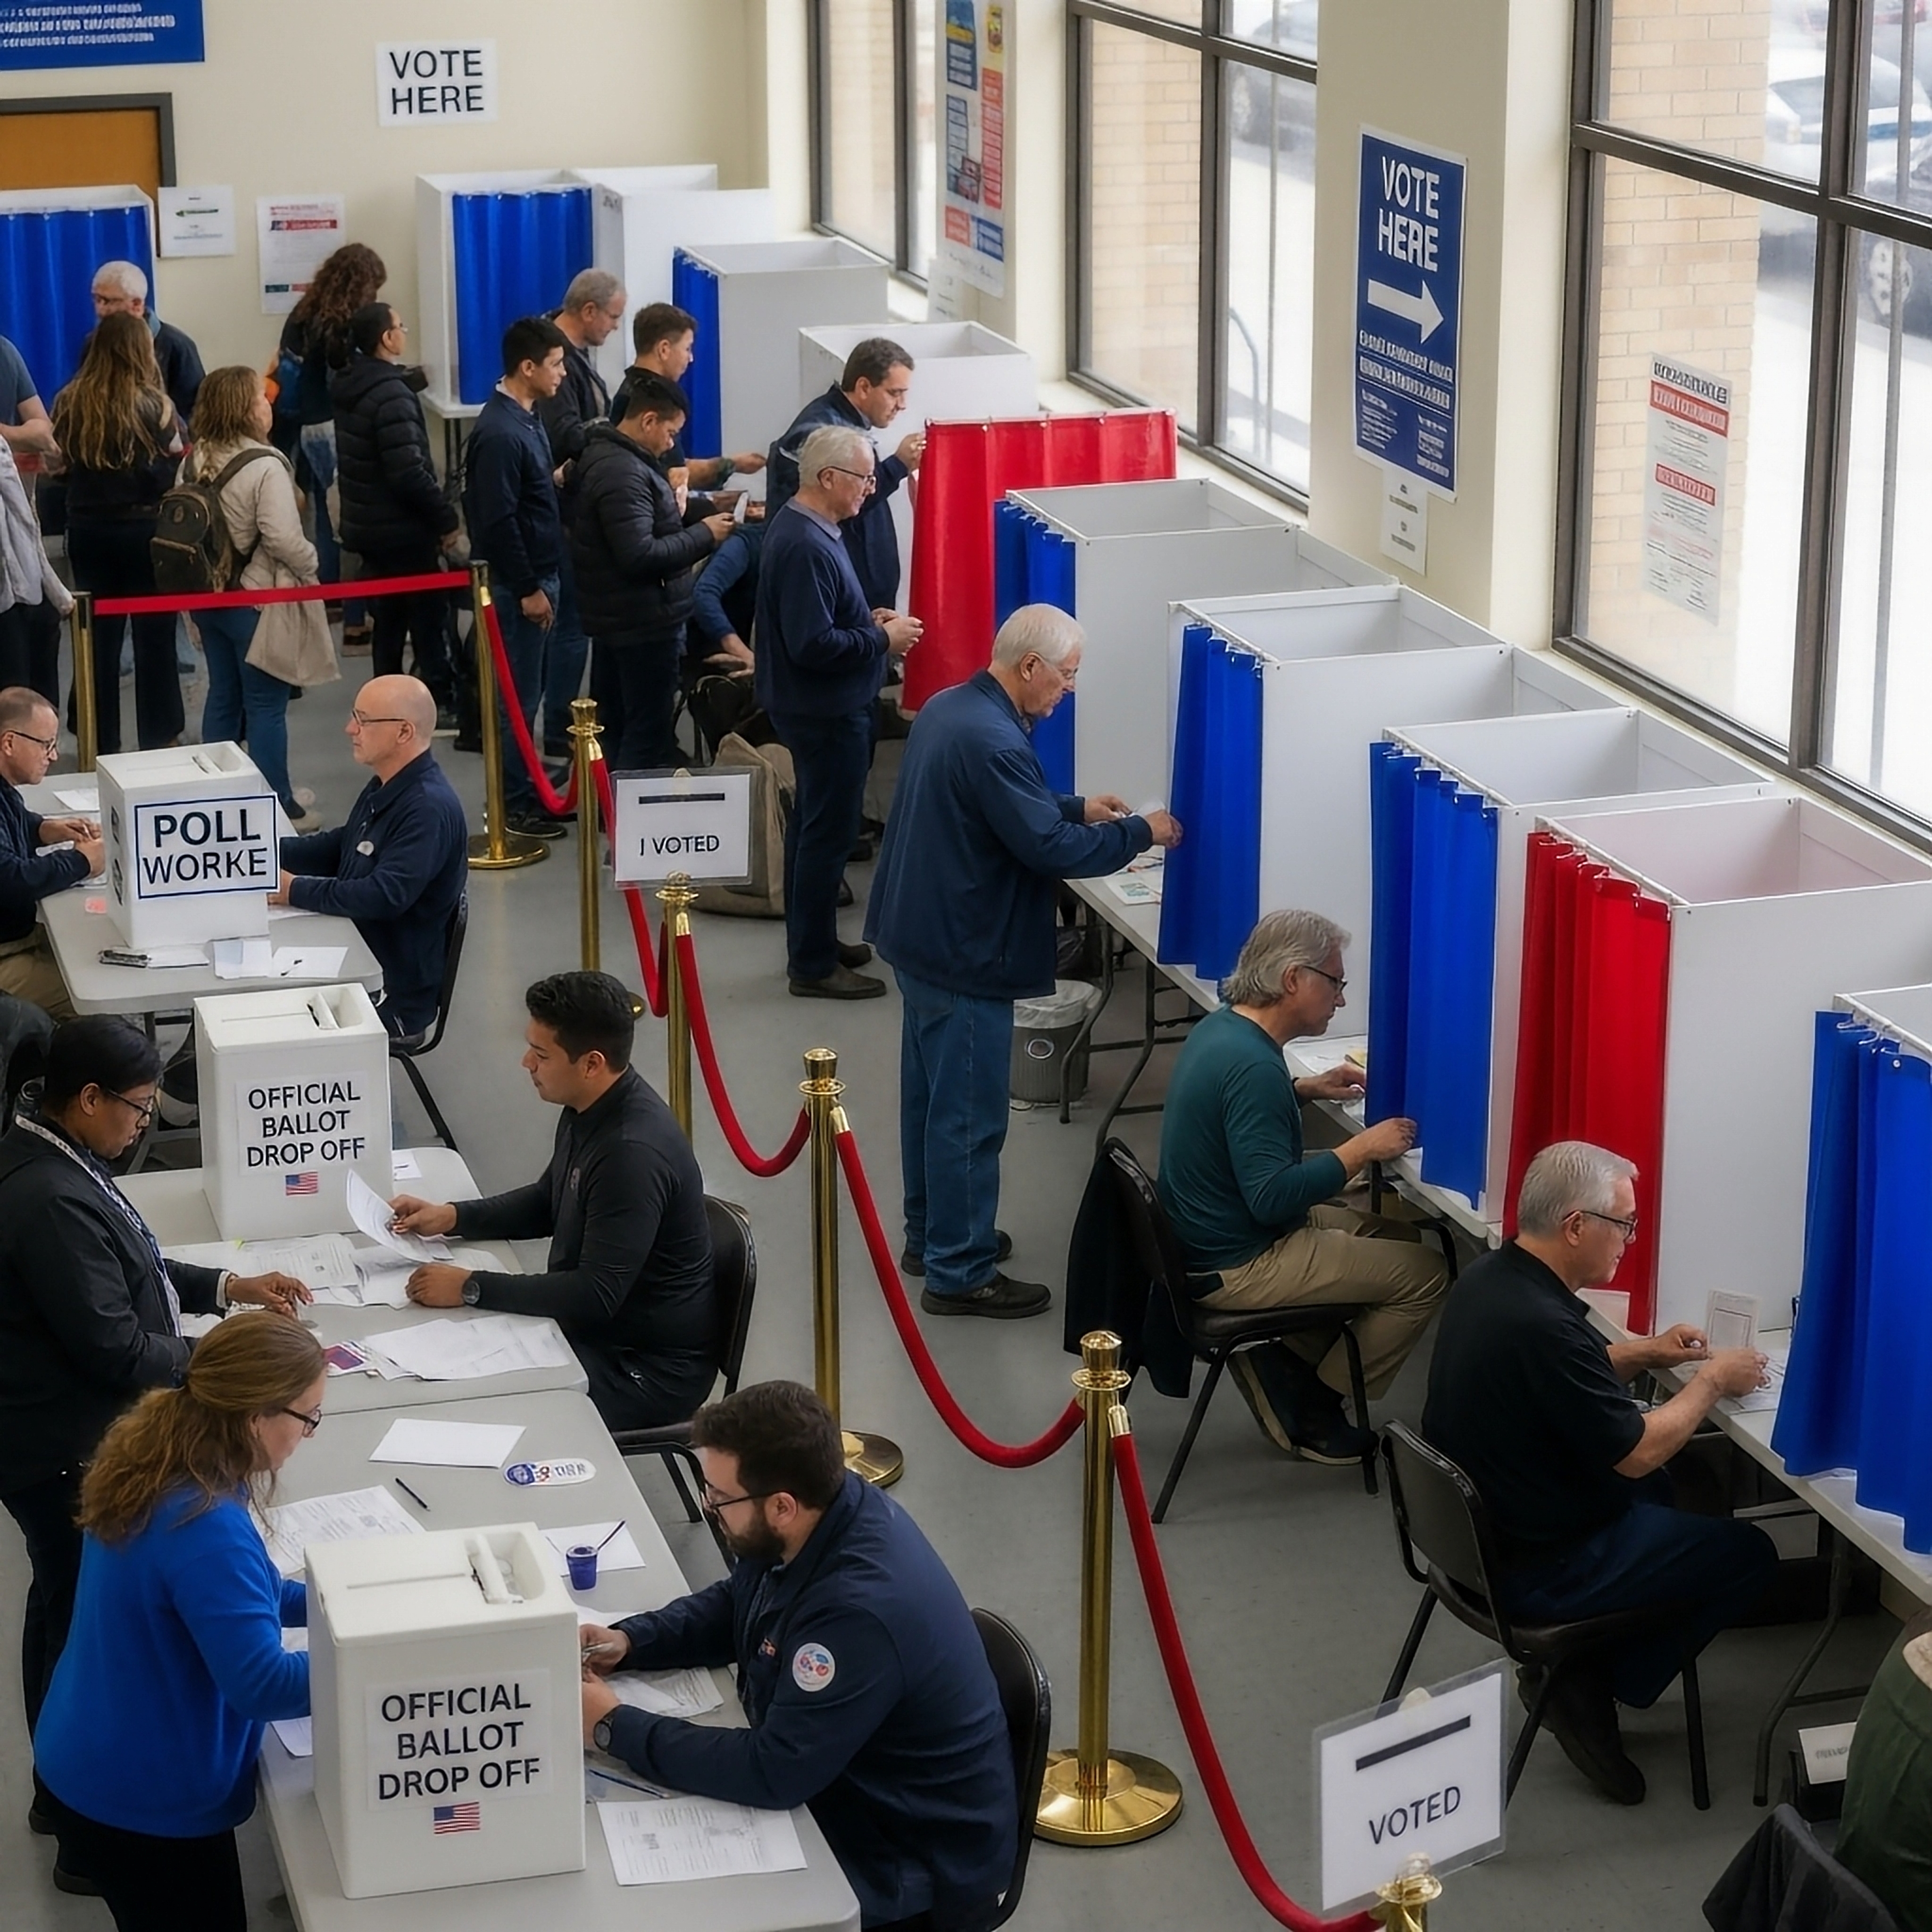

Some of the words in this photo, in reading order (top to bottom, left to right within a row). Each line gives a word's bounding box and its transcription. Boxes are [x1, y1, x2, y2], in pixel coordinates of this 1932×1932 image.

[389, 50, 483, 79] VOTE
[392, 85, 484, 114] HERE
[1382, 156, 1440, 219] VOTE
[1378, 208, 1439, 272] HERE
[153, 809, 261, 848] POLL
[640, 838, 644, 856] I
[652, 835, 719, 855] VOTED
[142, 848, 267, 884] WORKE
[248, 1081, 360, 1109] OFFICIAL
[262, 1110, 350, 1138] BALLOT
[247, 1142, 314, 1167] DROP
[321, 1137, 365, 1161] OFF
[381, 1683, 531, 1722] OFFICIAL
[397, 1721, 524, 1760] BALLOT
[379, 1766, 469, 1800] DROP
[479, 1757, 540, 1789] OFF
[1369, 1786, 1461, 1845] VOTED
